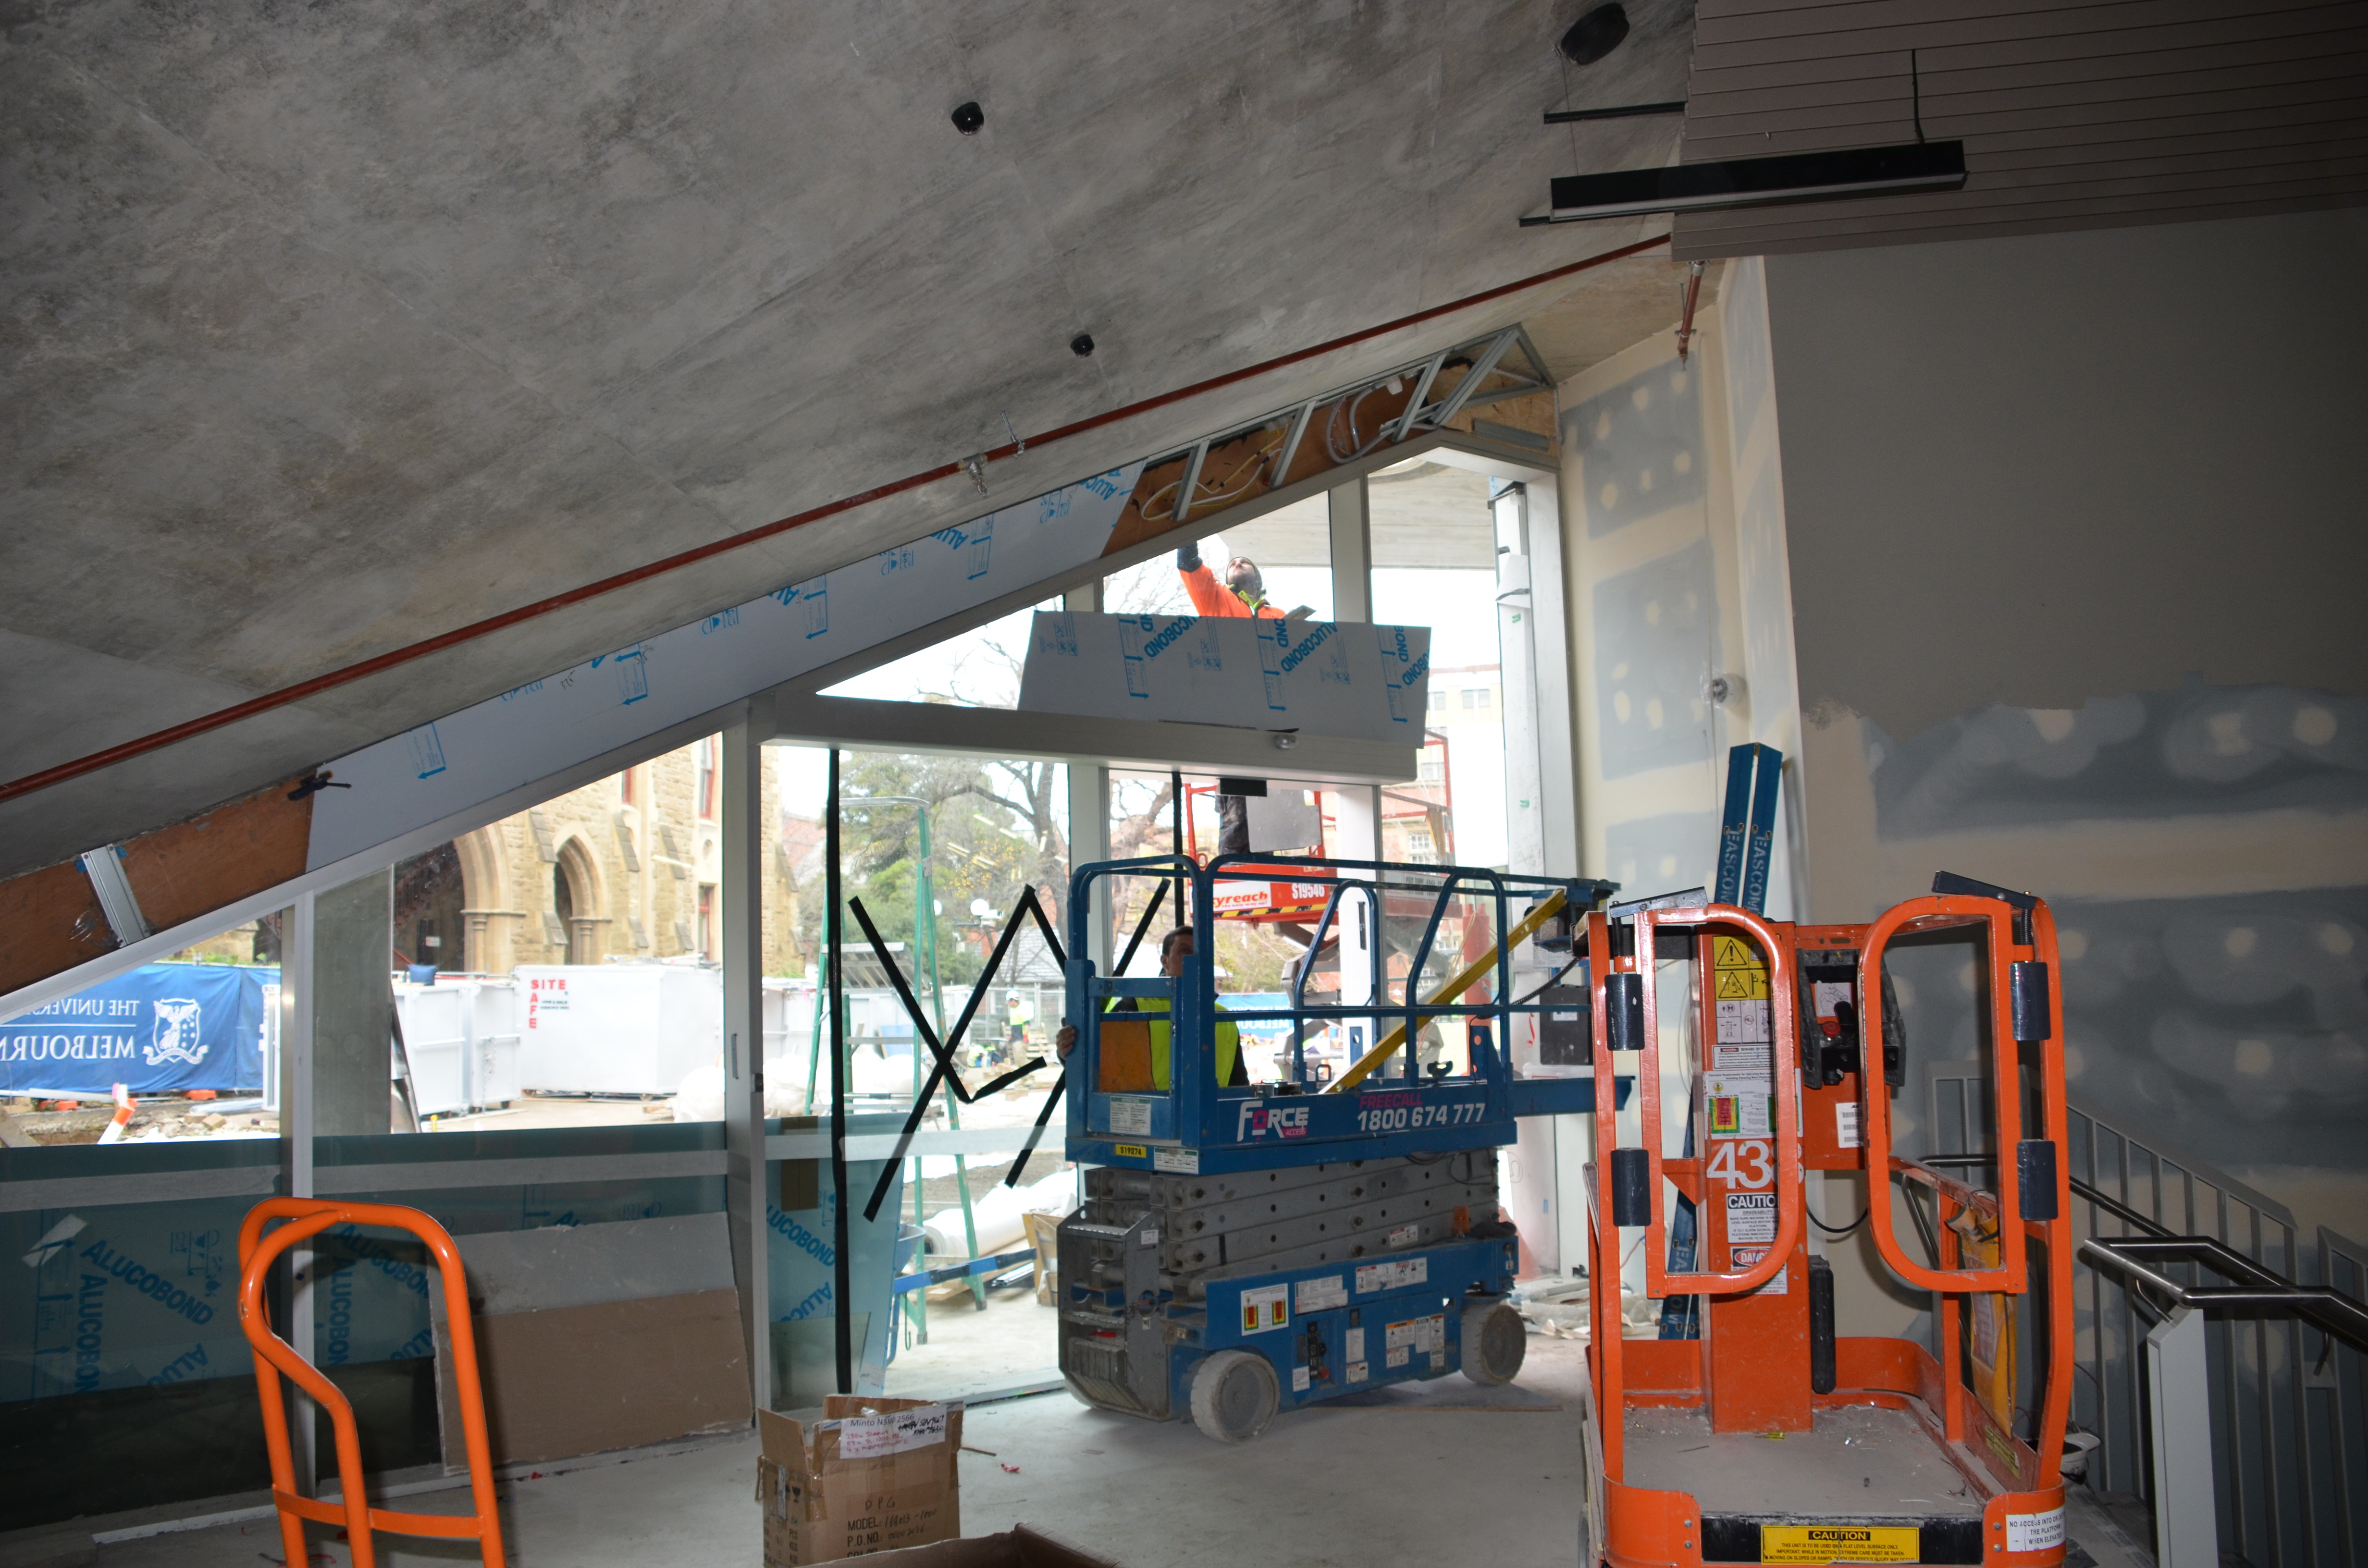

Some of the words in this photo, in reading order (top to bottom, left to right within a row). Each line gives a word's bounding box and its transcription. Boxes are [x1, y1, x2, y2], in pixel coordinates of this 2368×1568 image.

[1292, 883, 1325, 899] S19546
[1213, 892, 1268, 908] yreach
[531, 980, 566, 990] SITE
[1359, 1093, 1423, 1110] FREECALL
[1237, 1101, 1309, 1141] FORCE
[1357, 1108, 1407, 1131] 1800
[1412, 1105, 1447, 1127] 674
[1454, 1103, 1485, 1124] 777
[1120, 1146, 1142, 1155] S19274
[1728, 1195, 1776, 1208] CAUTIO
[80, 1240, 214, 1325] ALUCOBOND
[877, 1418, 894, 1426] NSW
[897, 1414, 914, 1423] 2566
[2041, 1523, 2061, 1534] PLATFORM
[1813, 1531, 1866, 1540] CAUTION
[2044, 1532, 2062, 1542] ELEVATED
